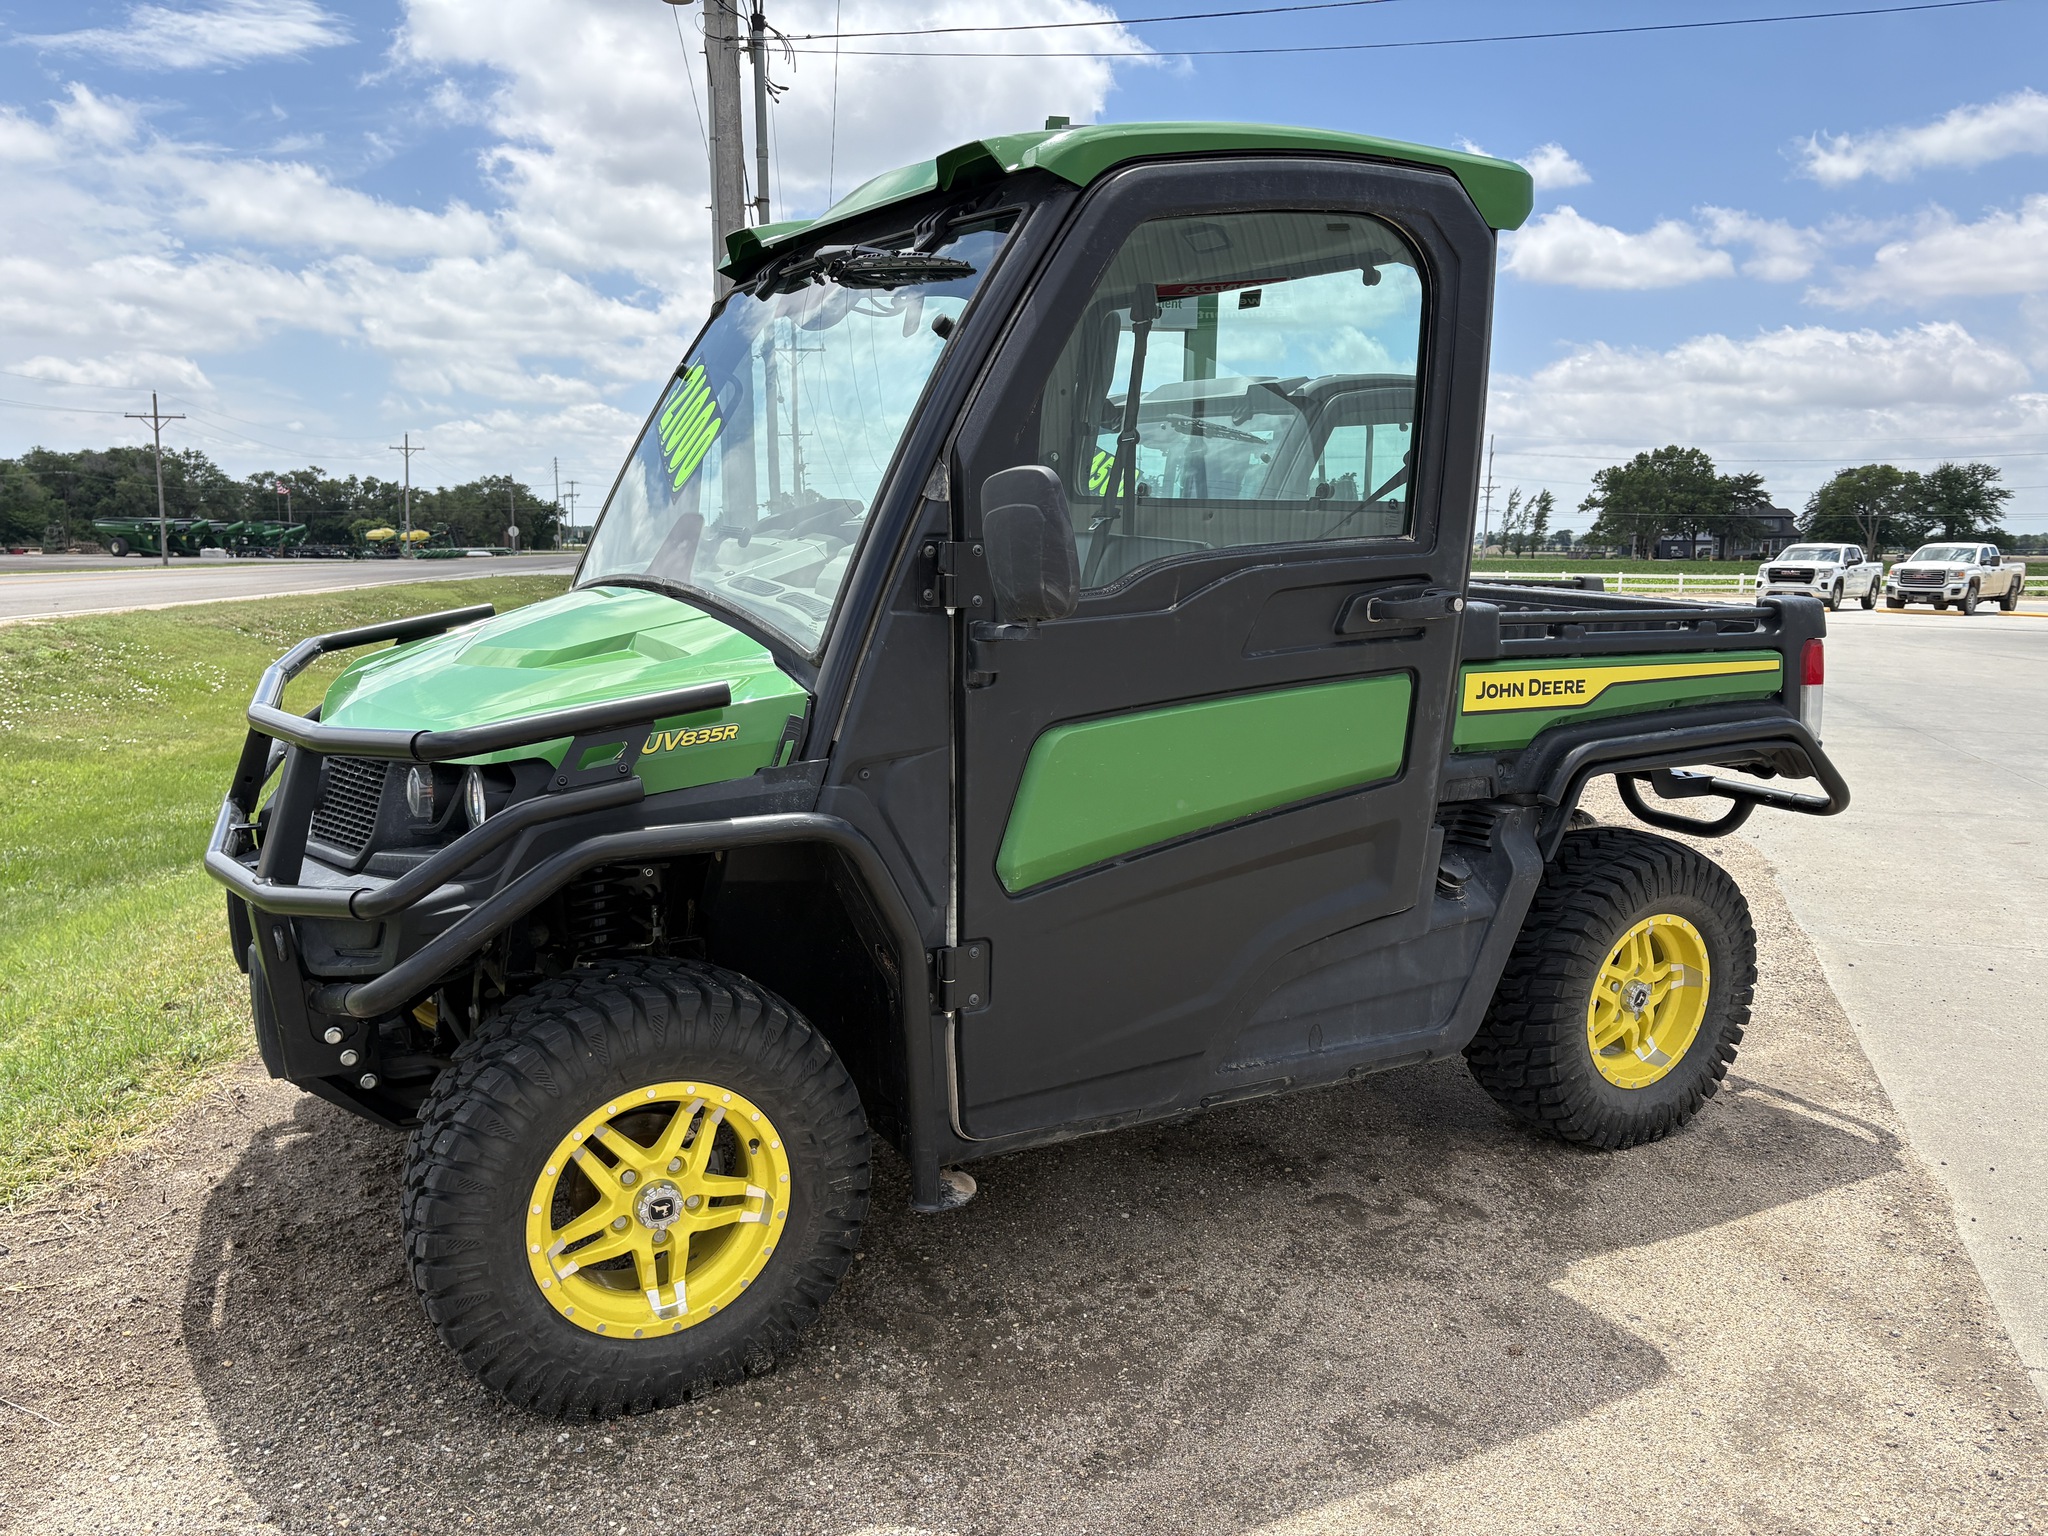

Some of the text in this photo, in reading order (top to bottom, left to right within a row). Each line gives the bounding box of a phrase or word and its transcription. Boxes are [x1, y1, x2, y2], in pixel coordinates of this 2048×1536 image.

[658, 357, 721, 492] 21000
[1476, 679, 1586, 699] JOHN DEERE
[617, 725, 739, 755] UV835R
